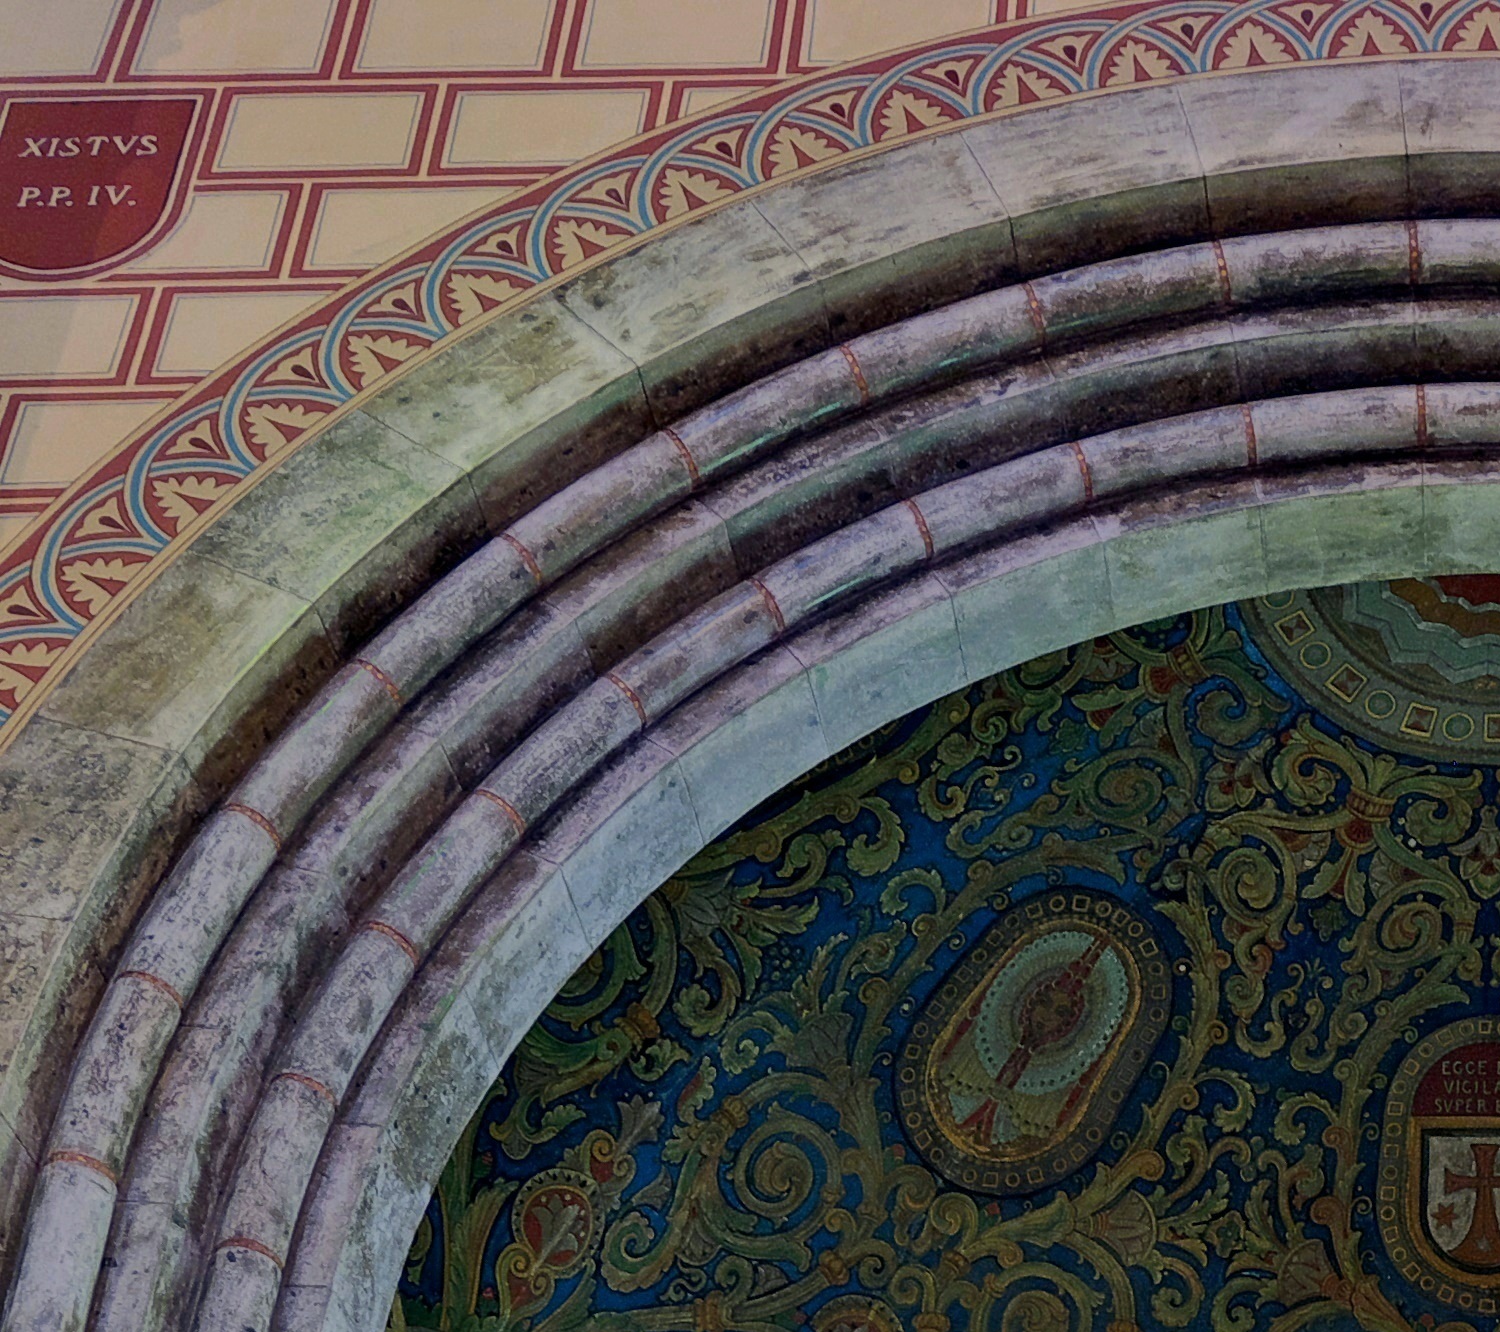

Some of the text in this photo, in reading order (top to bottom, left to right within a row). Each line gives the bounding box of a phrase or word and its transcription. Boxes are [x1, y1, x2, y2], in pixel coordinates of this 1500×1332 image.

[18, 135, 158, 157] XISTVS
[87, 184, 137, 206] IV.
[1434, 1099, 1487, 1114] SVPER
